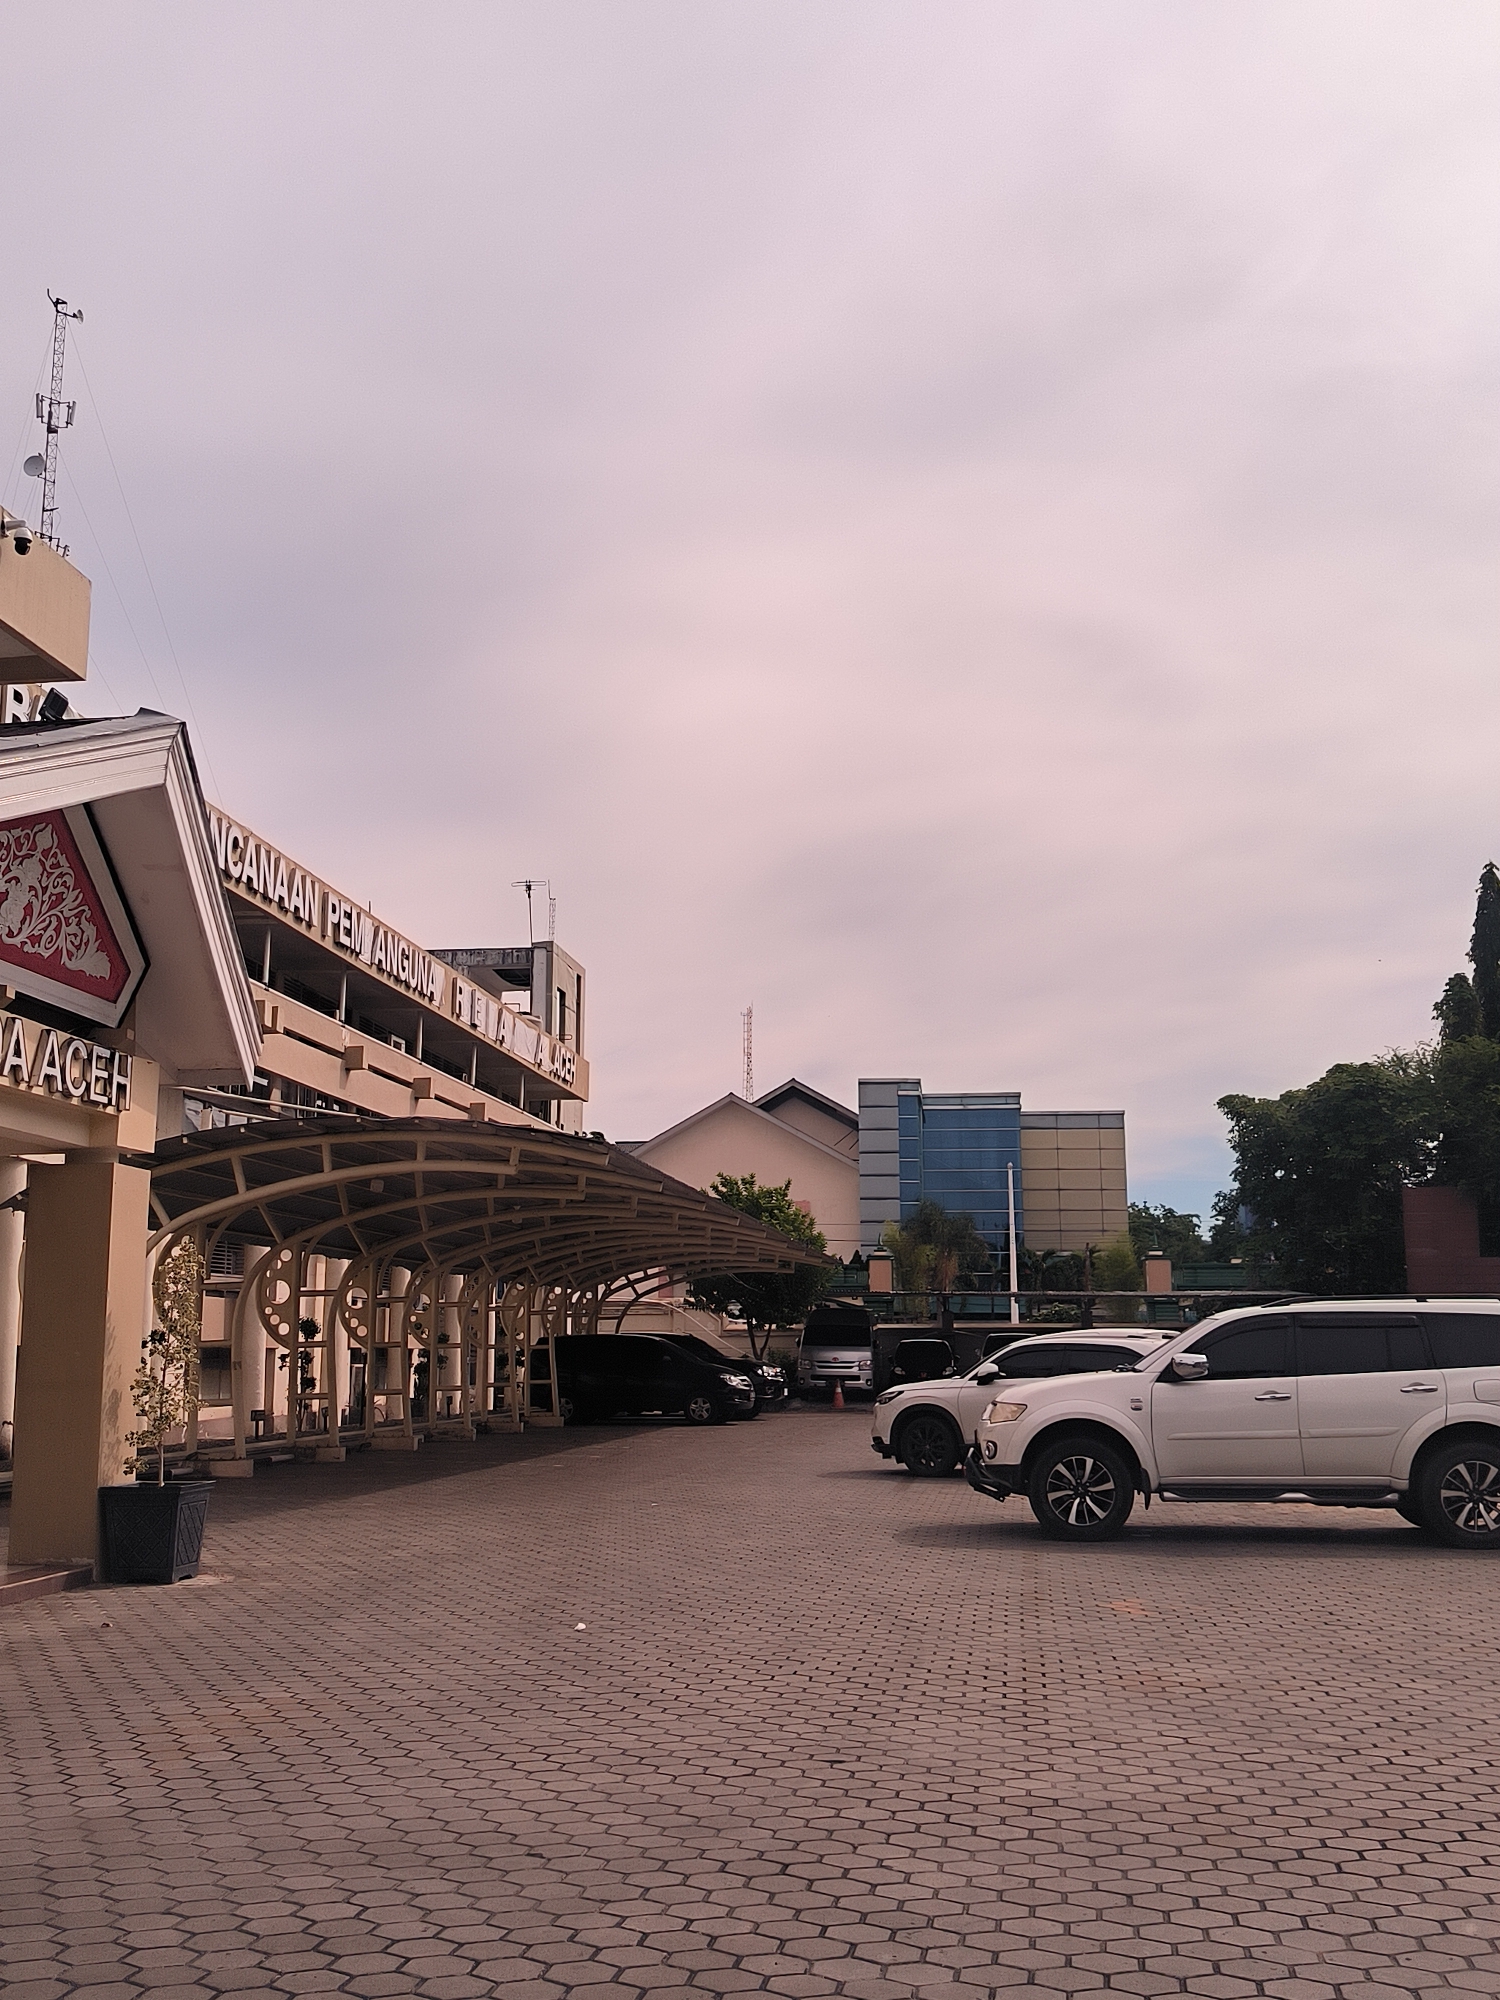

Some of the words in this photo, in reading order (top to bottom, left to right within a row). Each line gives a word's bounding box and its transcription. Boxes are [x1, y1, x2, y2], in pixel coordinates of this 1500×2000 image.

[206, 809, 319, 927] NCANAAN
[328, 891, 445, 1008] PEMANGUNA
[553, 1043, 577, 1084] ACEH
[0, 1018, 29, 1081] A
[38, 1031, 132, 1110] ACEH
